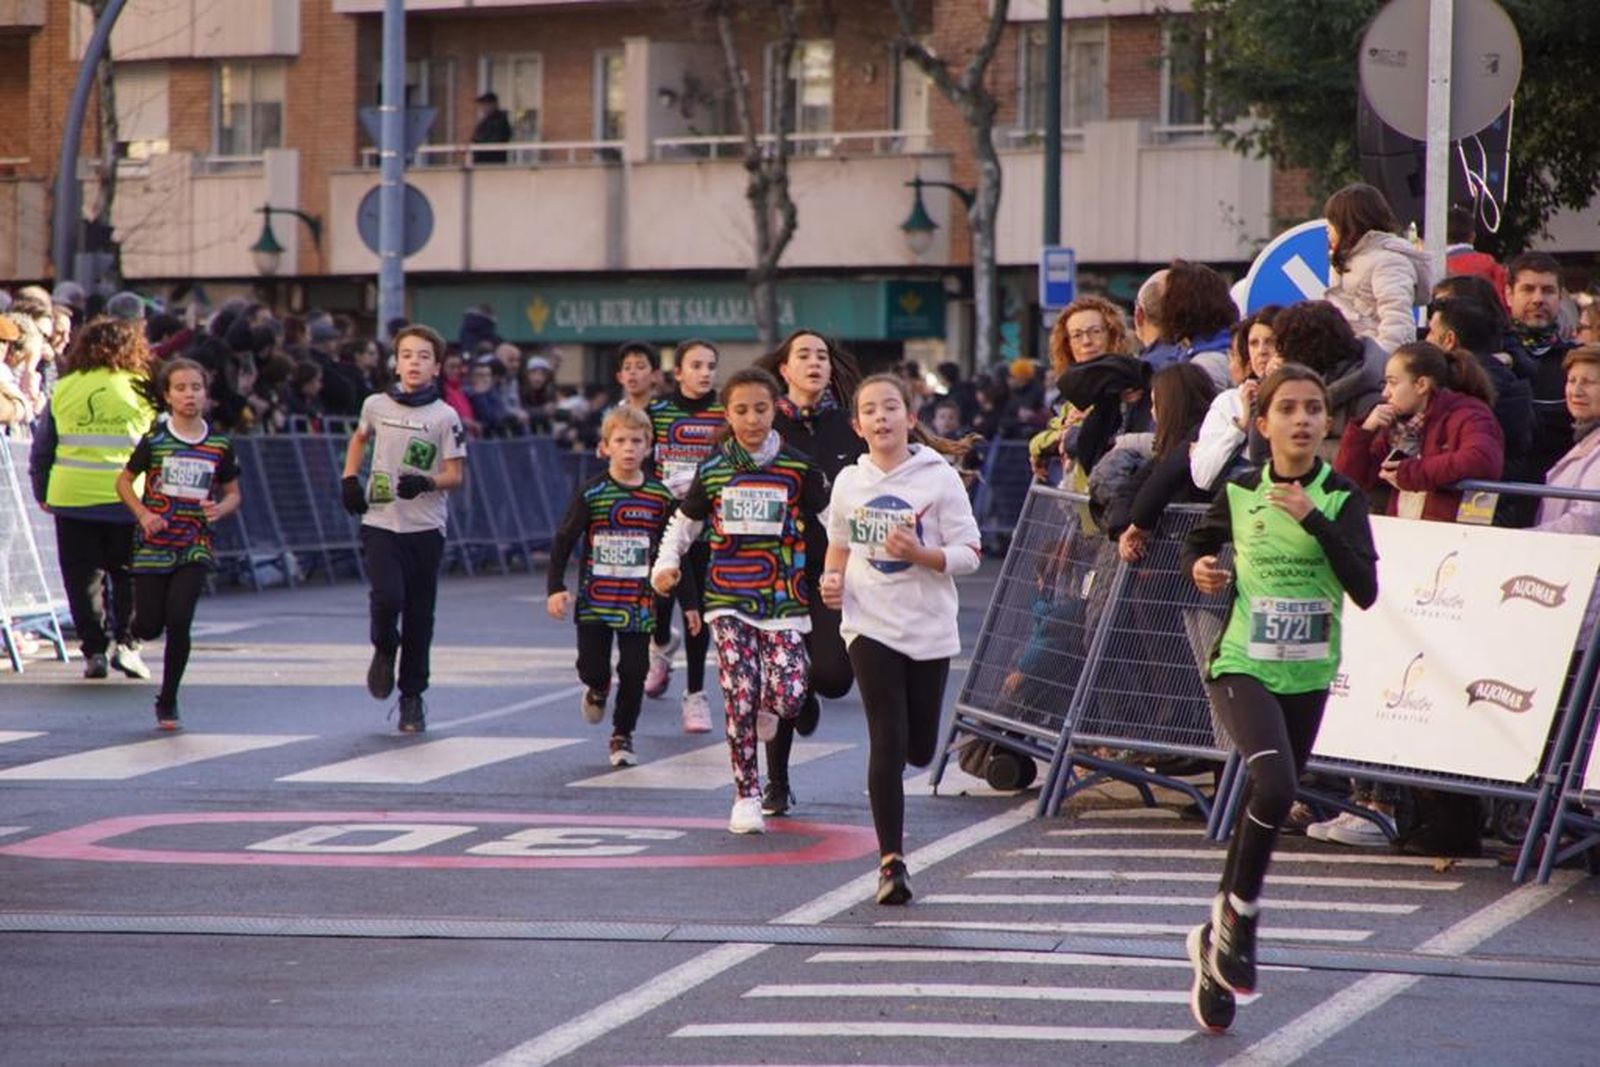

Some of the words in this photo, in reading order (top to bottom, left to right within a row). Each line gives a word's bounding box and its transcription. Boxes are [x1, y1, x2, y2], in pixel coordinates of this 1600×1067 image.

[555, 299, 596, 332] CAJA
[602, 299, 651, 326] RURAL
[657, 299, 681, 326] DE
[684, 299, 795, 326] SALAMAA
[168, 466, 203, 486] 5897
[732, 500, 769, 520] 5821
[599, 547, 636, 565] 5854
[1275, 600, 1327, 612] SETEL
[1265, 614, 1312, 640] 5721
[245, 824, 687, 856] 30
